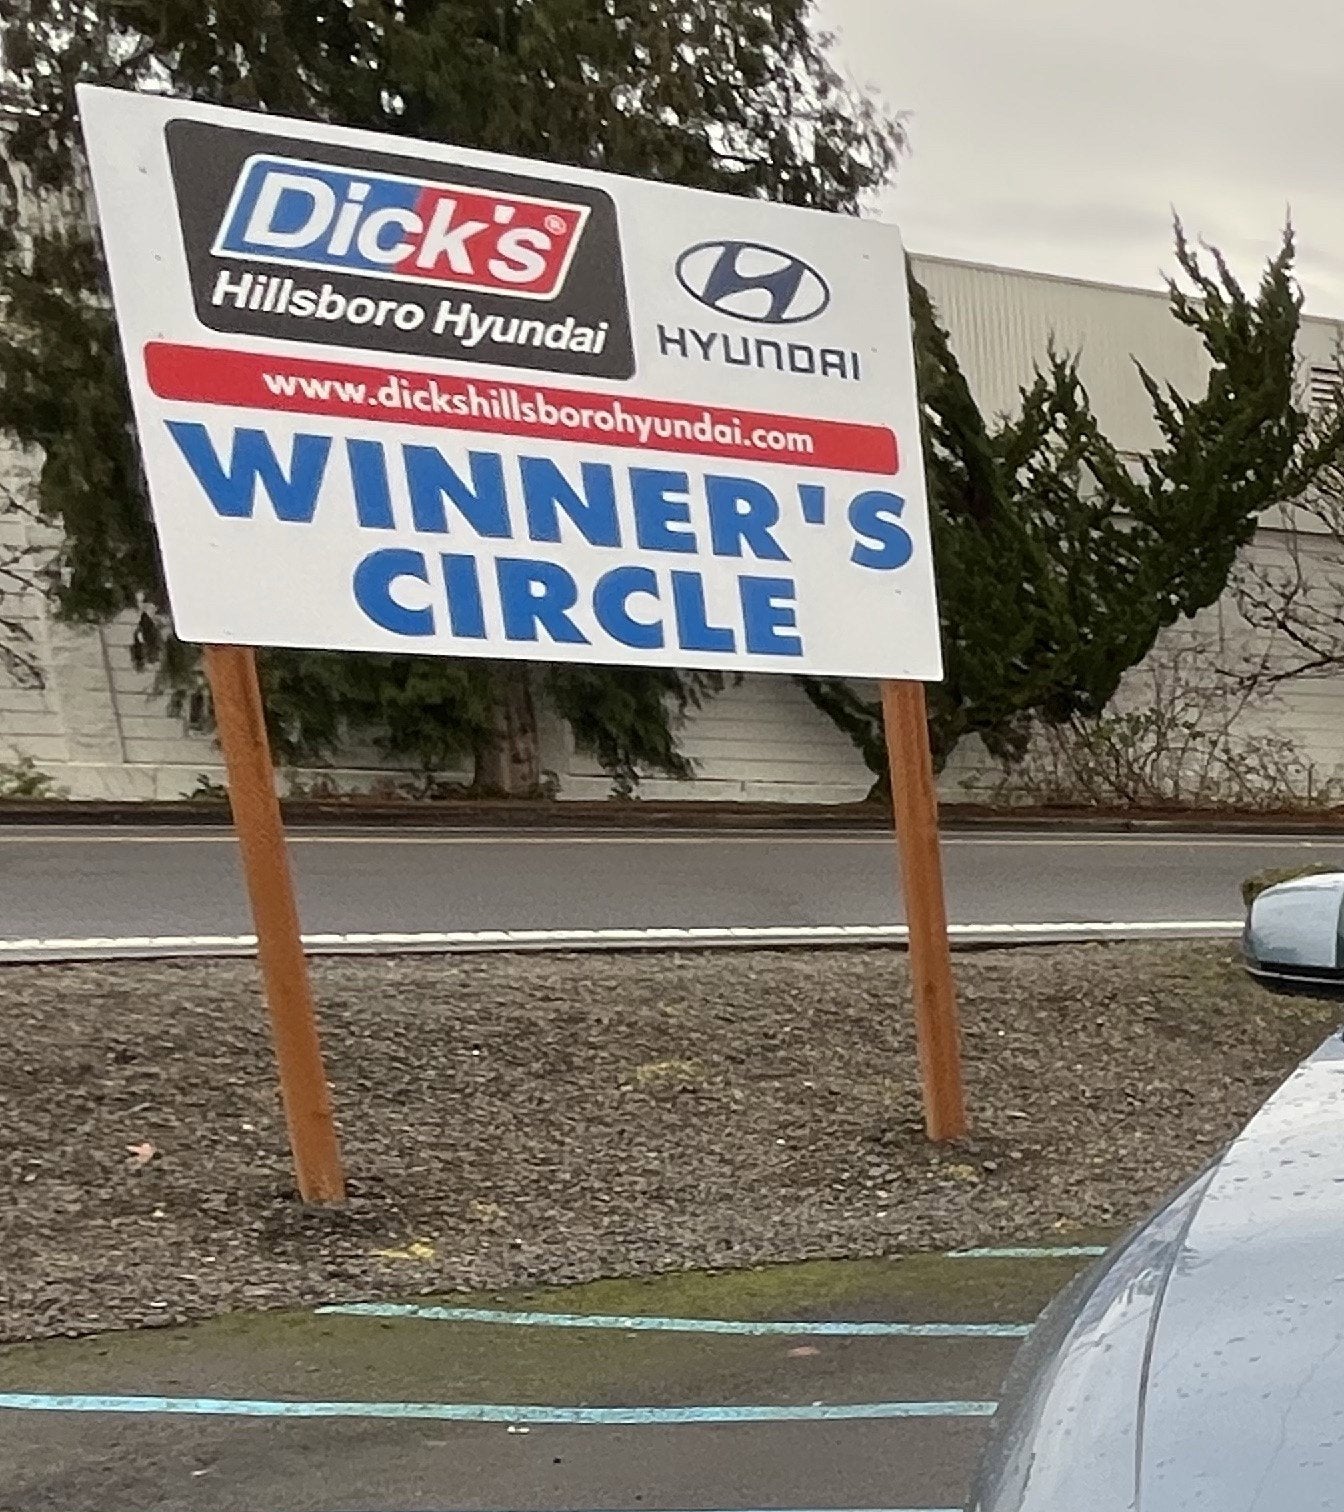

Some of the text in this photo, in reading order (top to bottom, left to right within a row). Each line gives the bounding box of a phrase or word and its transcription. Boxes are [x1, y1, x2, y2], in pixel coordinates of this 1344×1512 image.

[212, 270, 608, 356] Hillsboro Hyundai
[658, 323, 861, 381] HYUNDAI
[264, 368, 815, 455] www.dickshillsborohyundai.com
[165, 420, 915, 571] WINNER'S
[352, 547, 803, 657] CIRCLE
